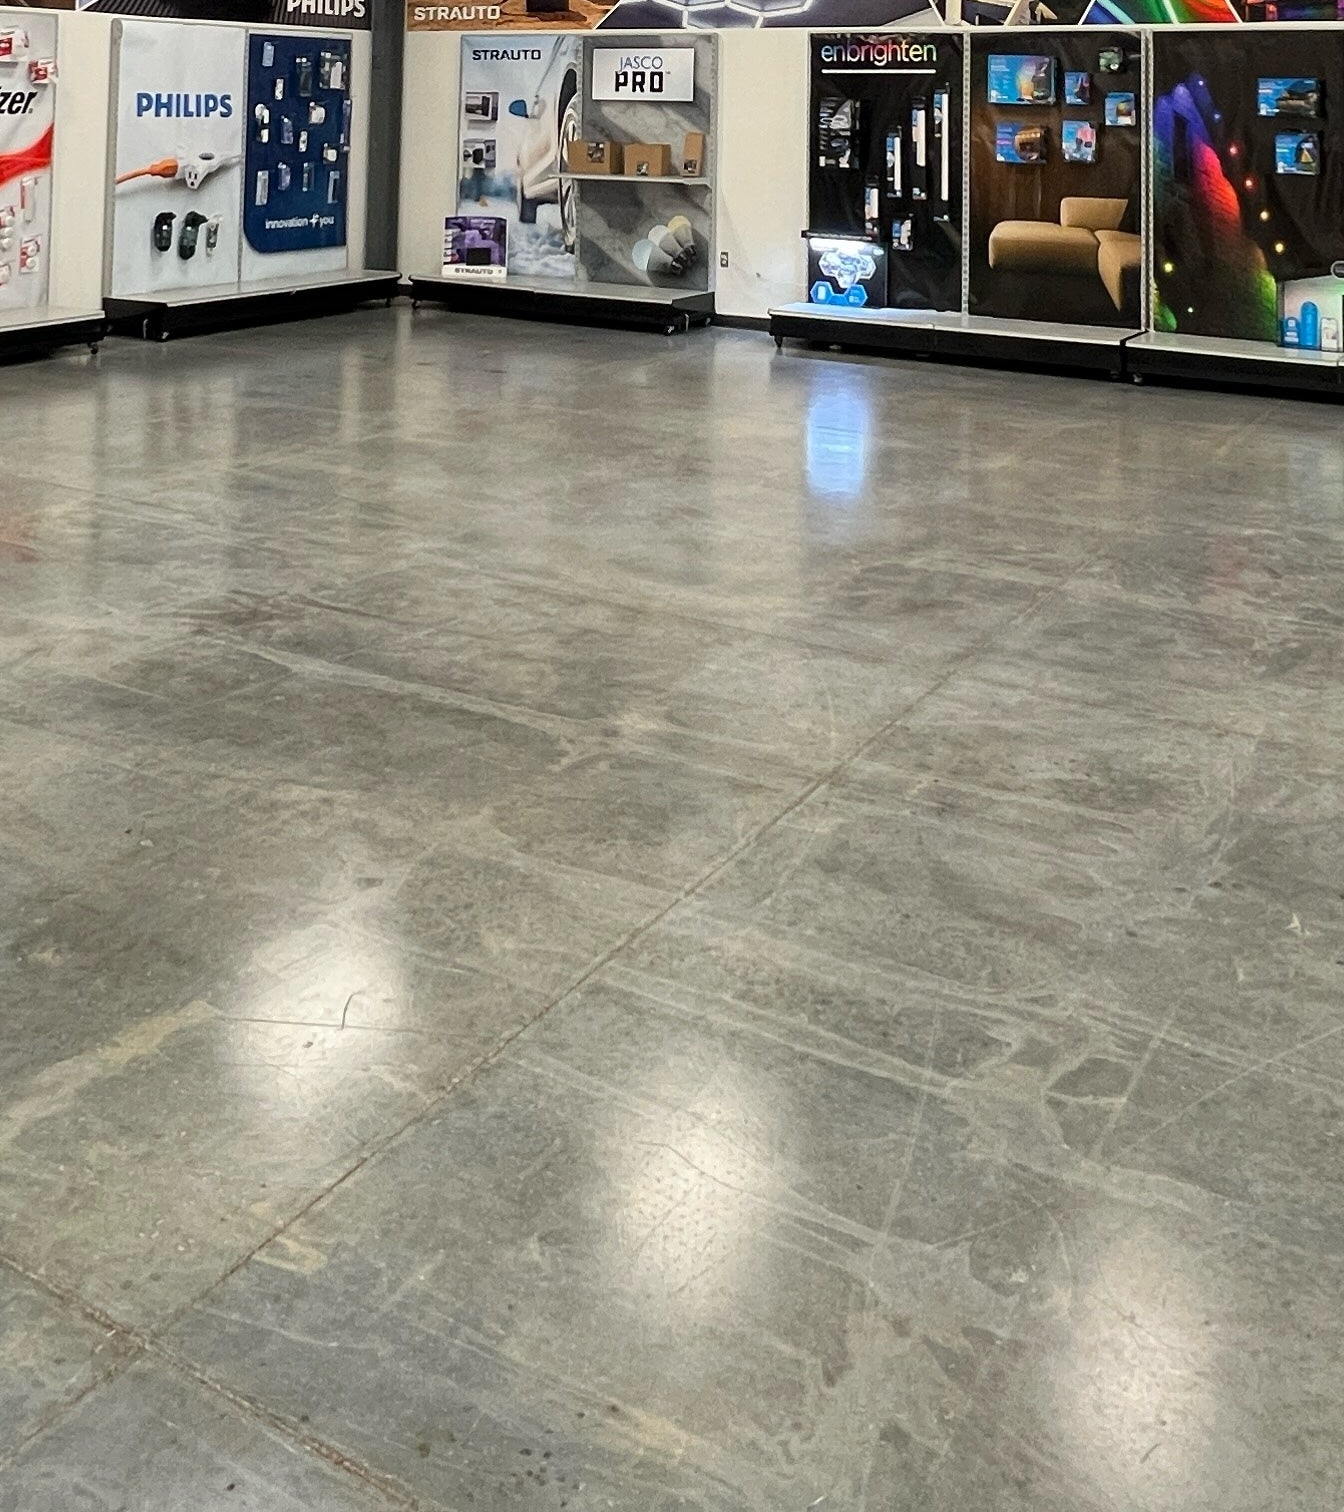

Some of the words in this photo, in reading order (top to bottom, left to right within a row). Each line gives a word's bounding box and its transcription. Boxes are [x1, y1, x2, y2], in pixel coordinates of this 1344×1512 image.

[413, 5, 501, 21] STRAUTO
[472, 49, 542, 61] STRAUTO
[821, 39, 937, 67] enbrighten
[620, 56, 664, 73] JASCO
[614, 71, 664, 93] PRO
[136, 92, 233, 118] PHILIPS
[265, 216, 309, 229] innovation
[319, 216, 335, 229] you
